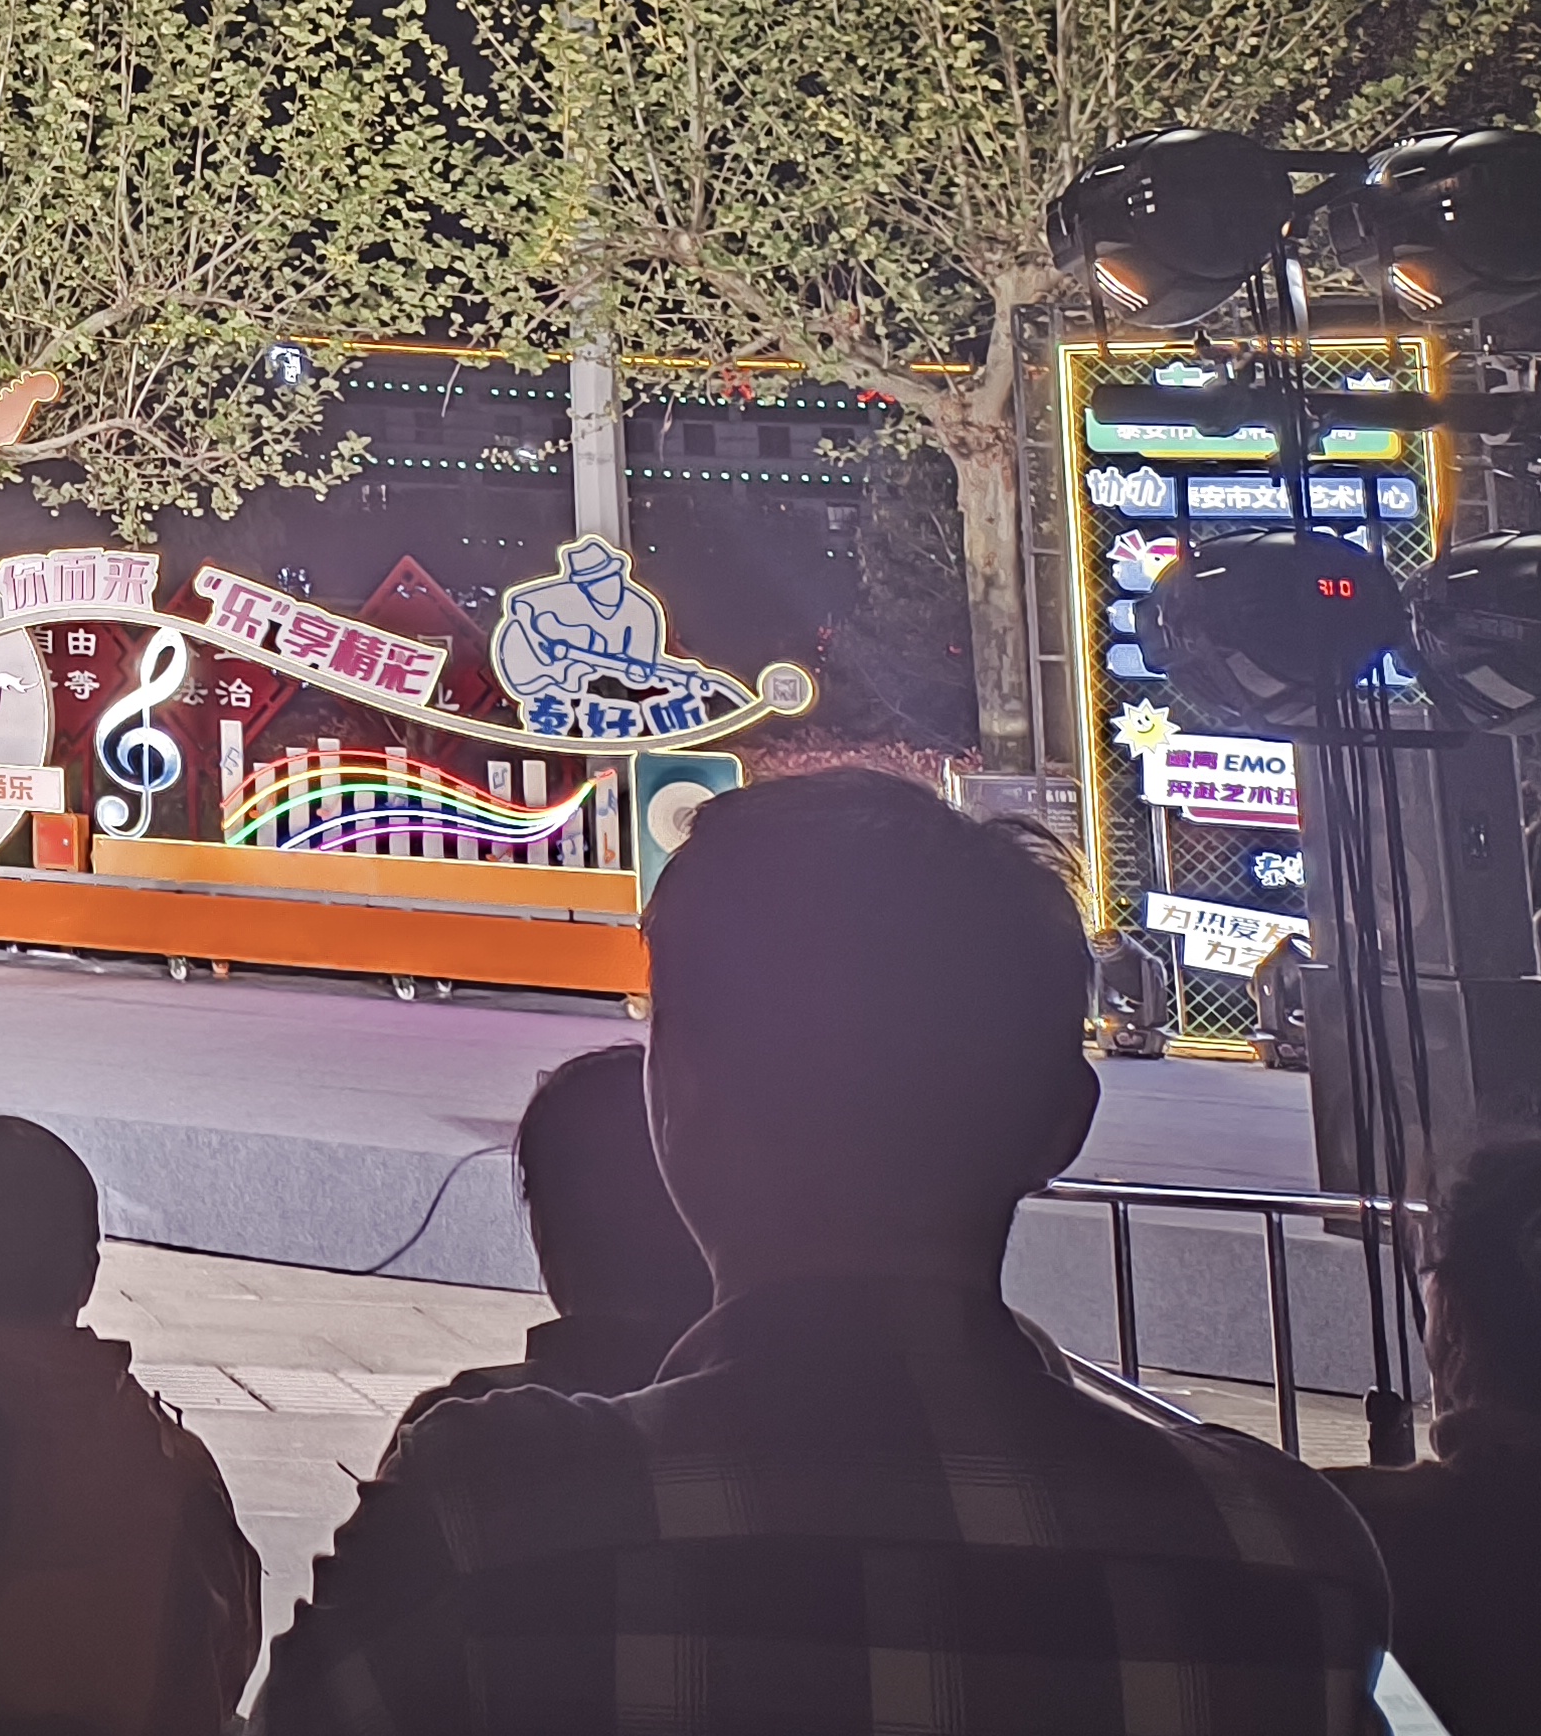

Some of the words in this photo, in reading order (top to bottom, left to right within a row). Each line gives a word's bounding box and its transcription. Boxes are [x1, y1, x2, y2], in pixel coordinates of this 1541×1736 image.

[529, 692, 705, 736] 泰好听
[1224, 754, 1286, 775] EMO
